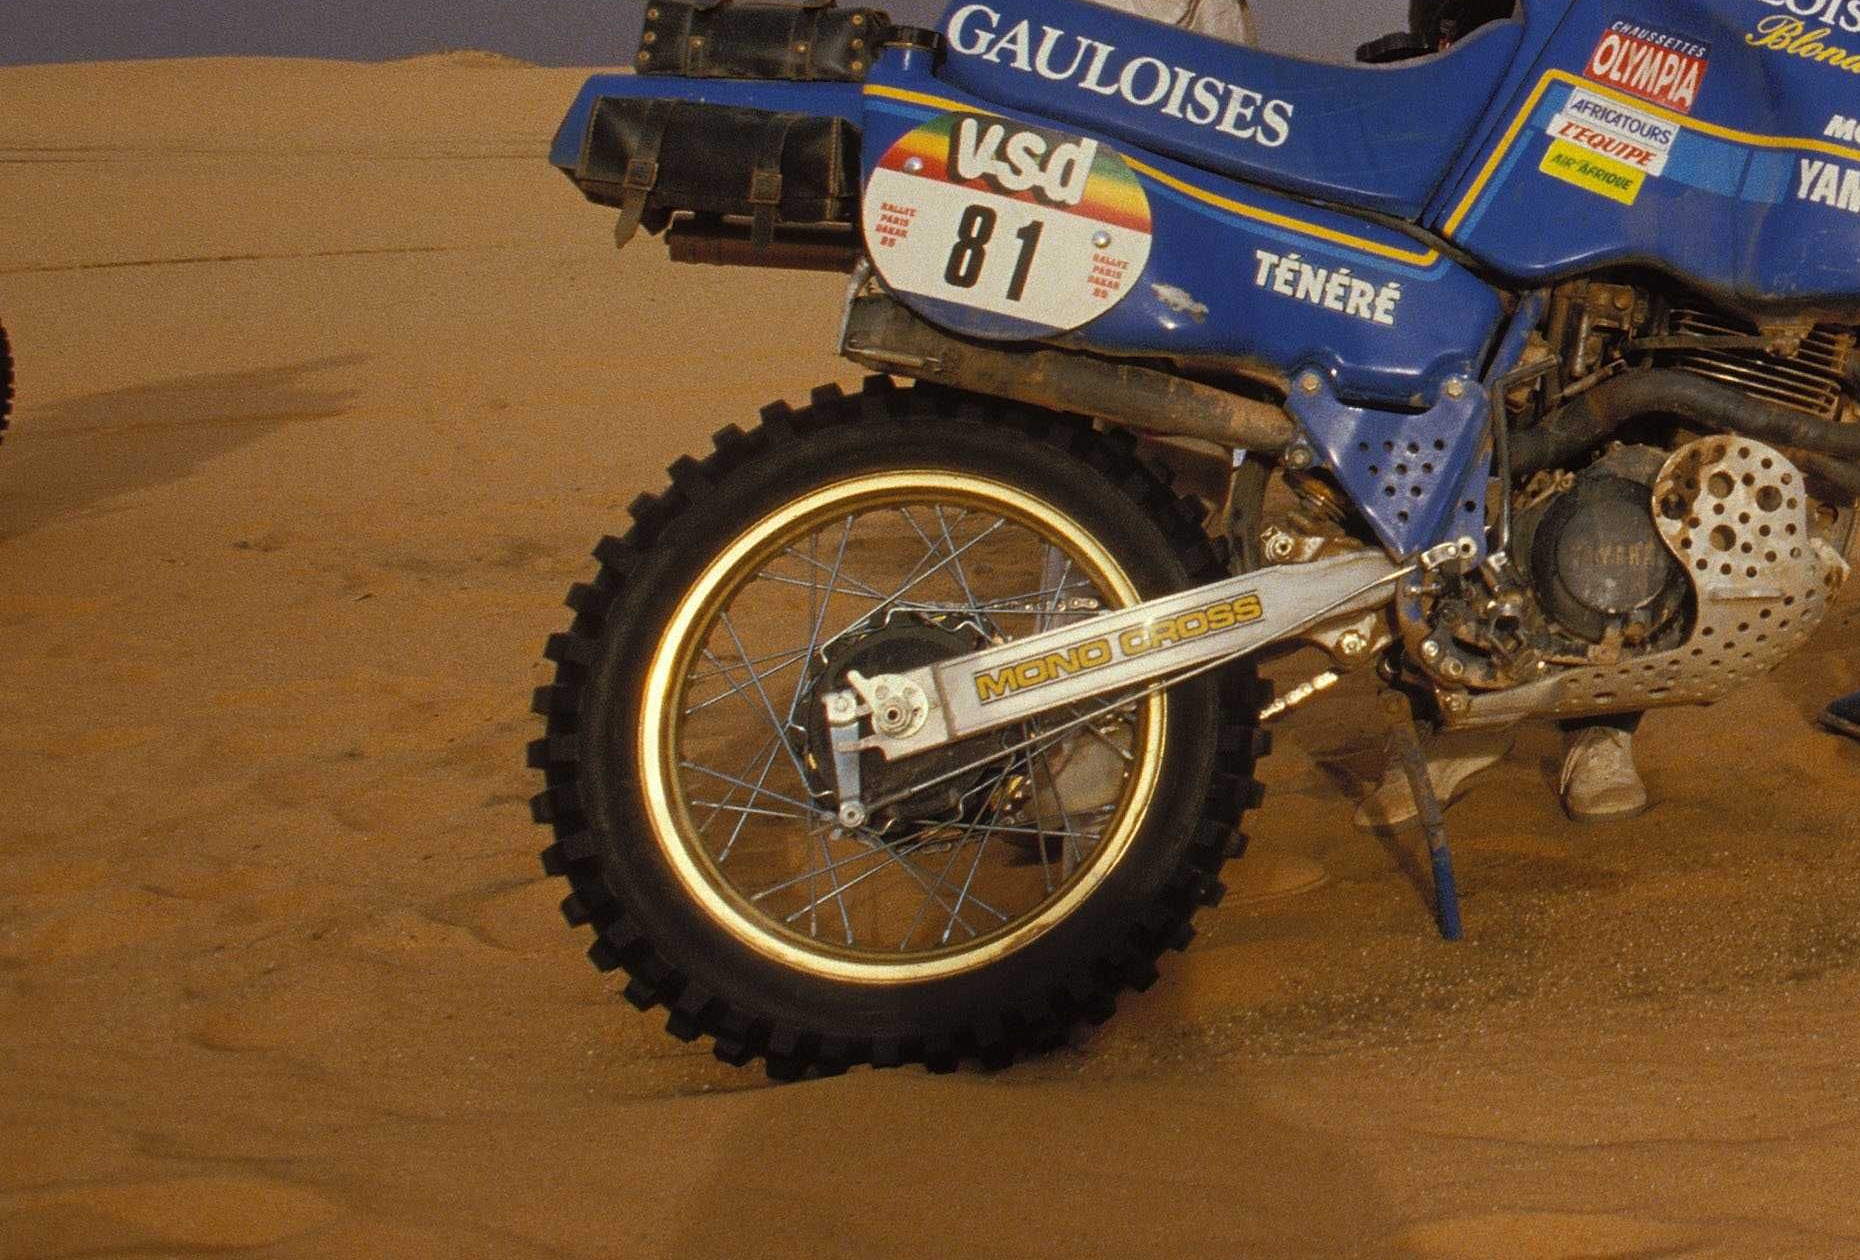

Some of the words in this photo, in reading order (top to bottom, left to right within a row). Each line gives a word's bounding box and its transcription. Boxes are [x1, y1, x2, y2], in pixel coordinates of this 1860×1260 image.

[947, 4, 1294, 147] GAULOISES
[1592, 33, 1700, 107] OLYMPIA
[1611, 20, 1707, 58] CHAUSSETTES
[1570, 99, 1673, 145] AFRICATOURS
[944, 203, 1045, 302] 81
[1255, 249, 1401, 326] TÉNÉRÉ
[974, 637, 1113, 702] MONO
[1118, 593, 1264, 657] CROSS
